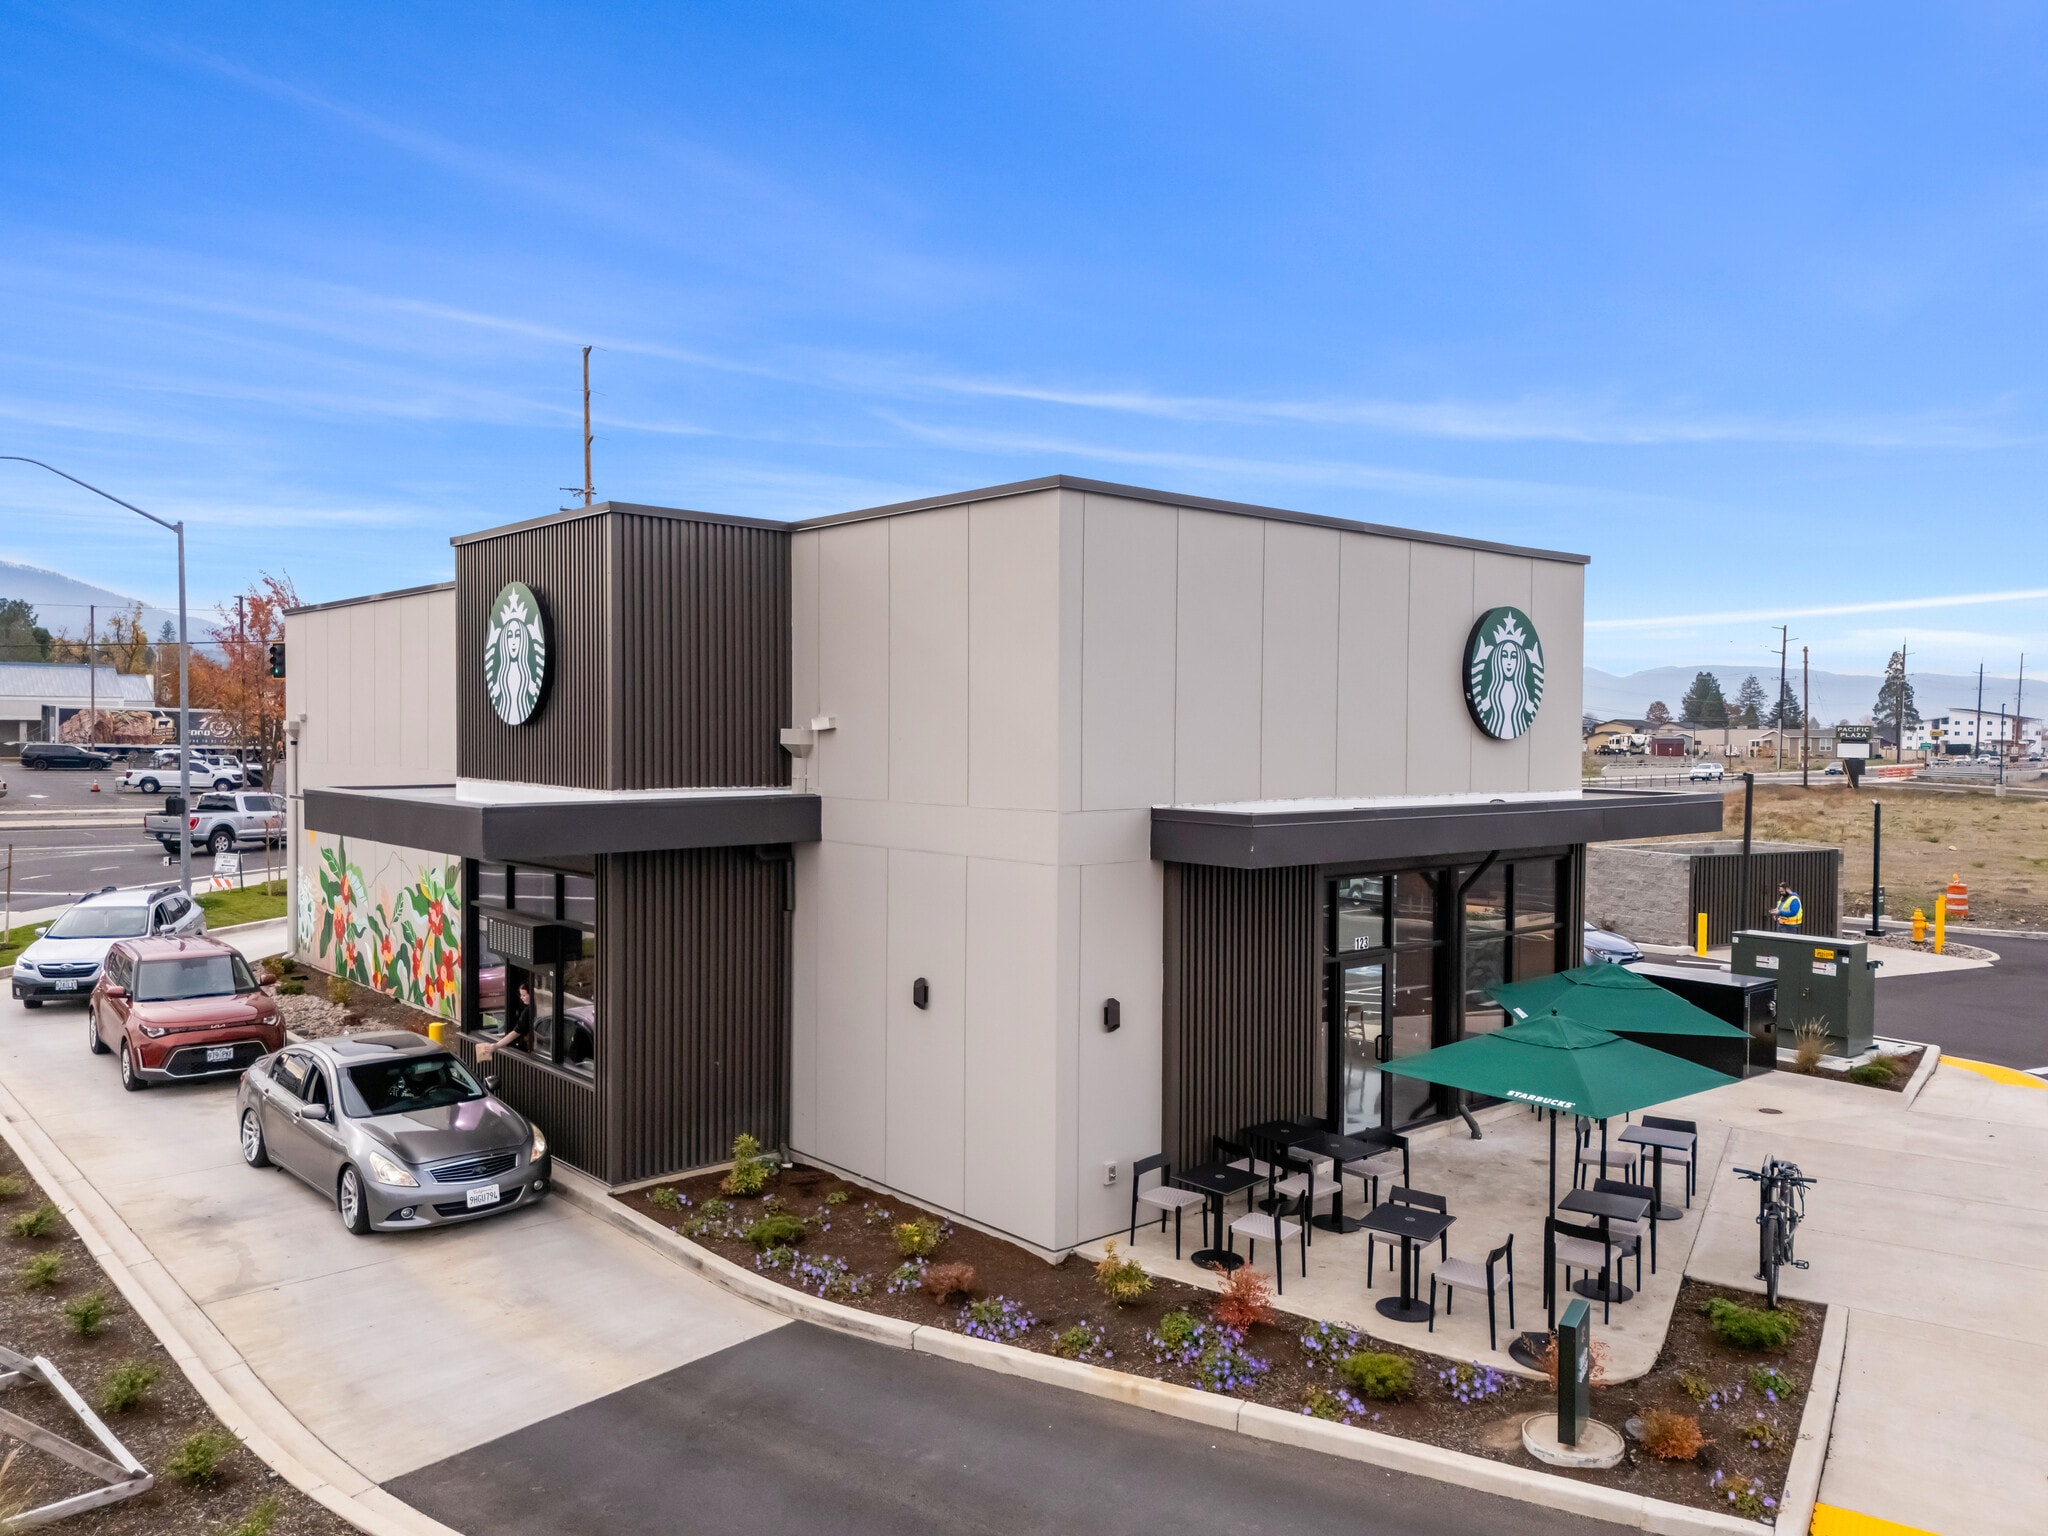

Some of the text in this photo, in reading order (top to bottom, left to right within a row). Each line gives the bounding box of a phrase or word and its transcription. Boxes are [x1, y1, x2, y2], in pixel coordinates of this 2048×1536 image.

[1355, 936, 1369, 950] 123
[1506, 1090, 1573, 1108] STARBUCKS
[469, 1191, 498, 1205] 9HGU794
